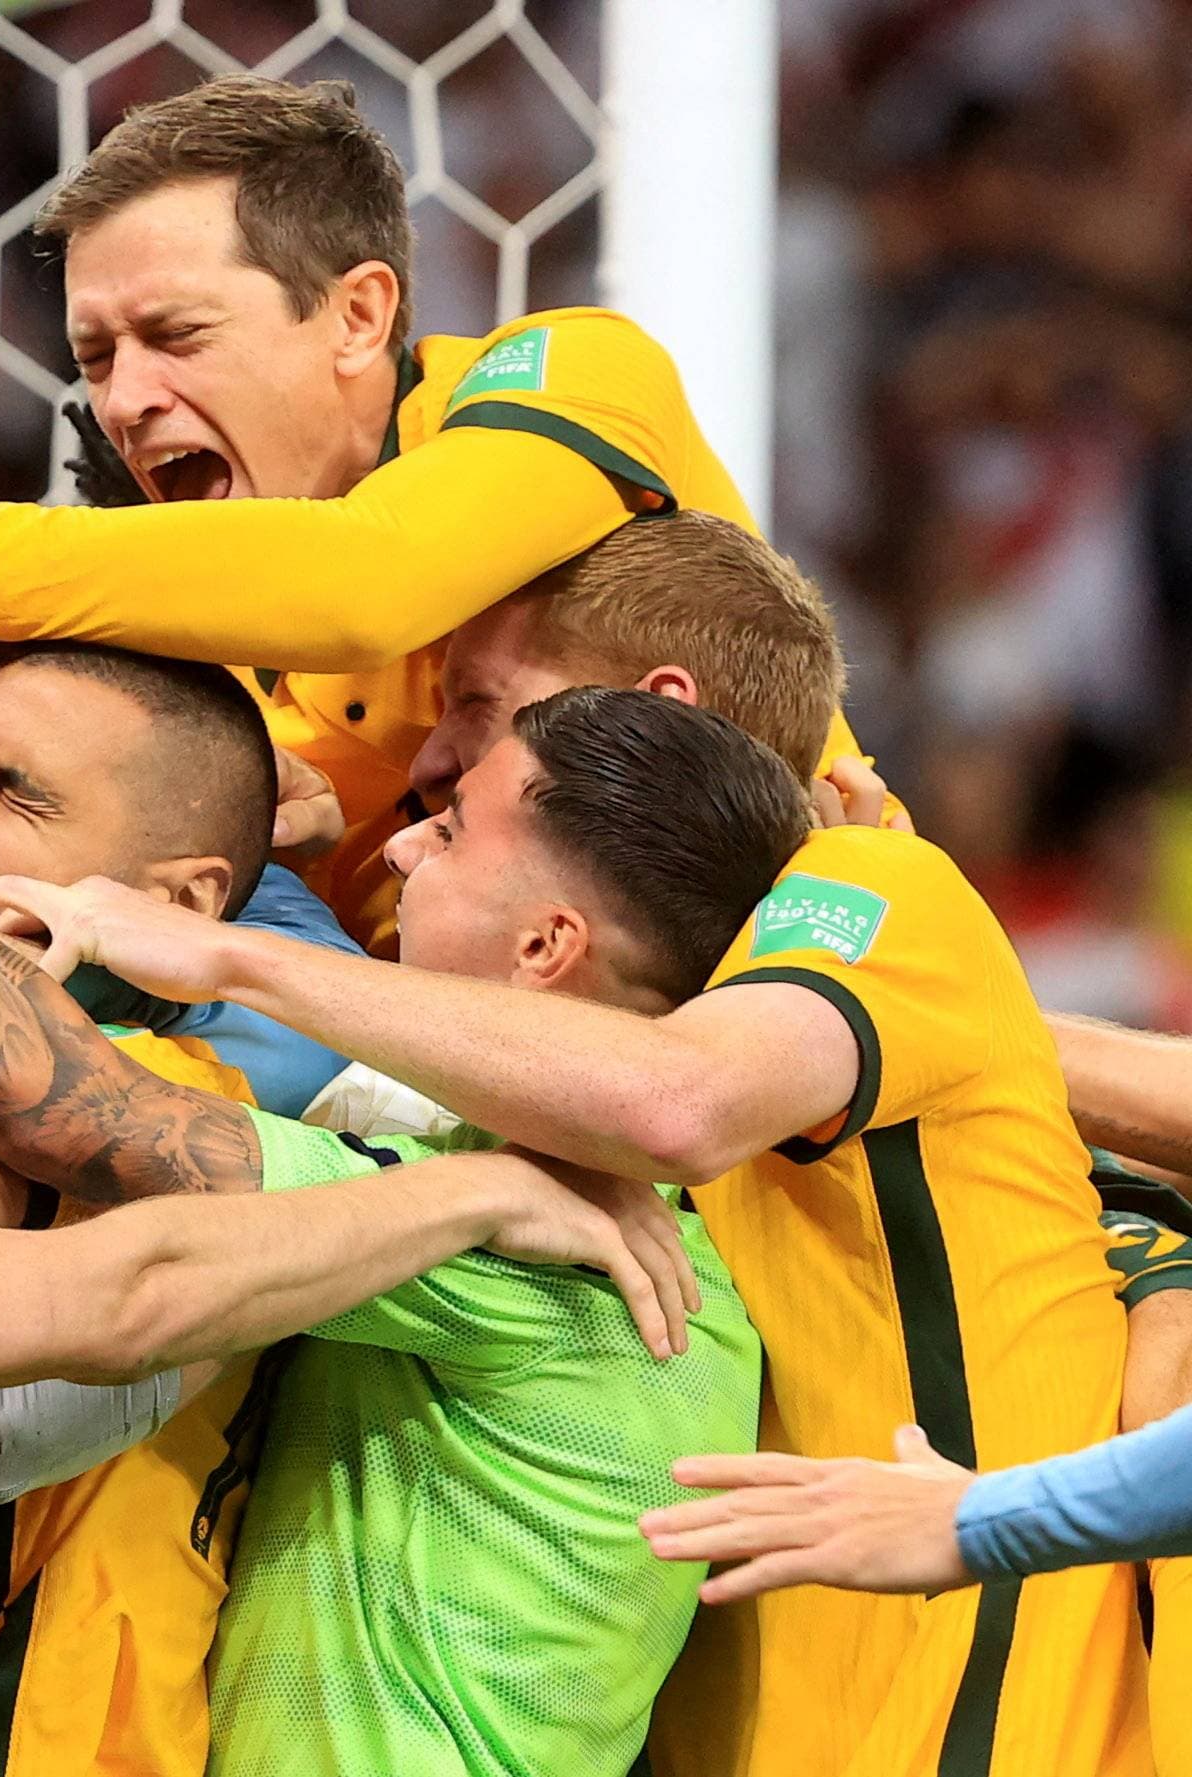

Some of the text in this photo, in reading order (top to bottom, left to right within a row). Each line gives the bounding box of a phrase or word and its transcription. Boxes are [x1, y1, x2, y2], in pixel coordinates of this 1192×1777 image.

[765, 906, 863, 938] FOOTBALL
[767, 898, 868, 928] LIVING
[811, 927, 857, 955] FIFA
